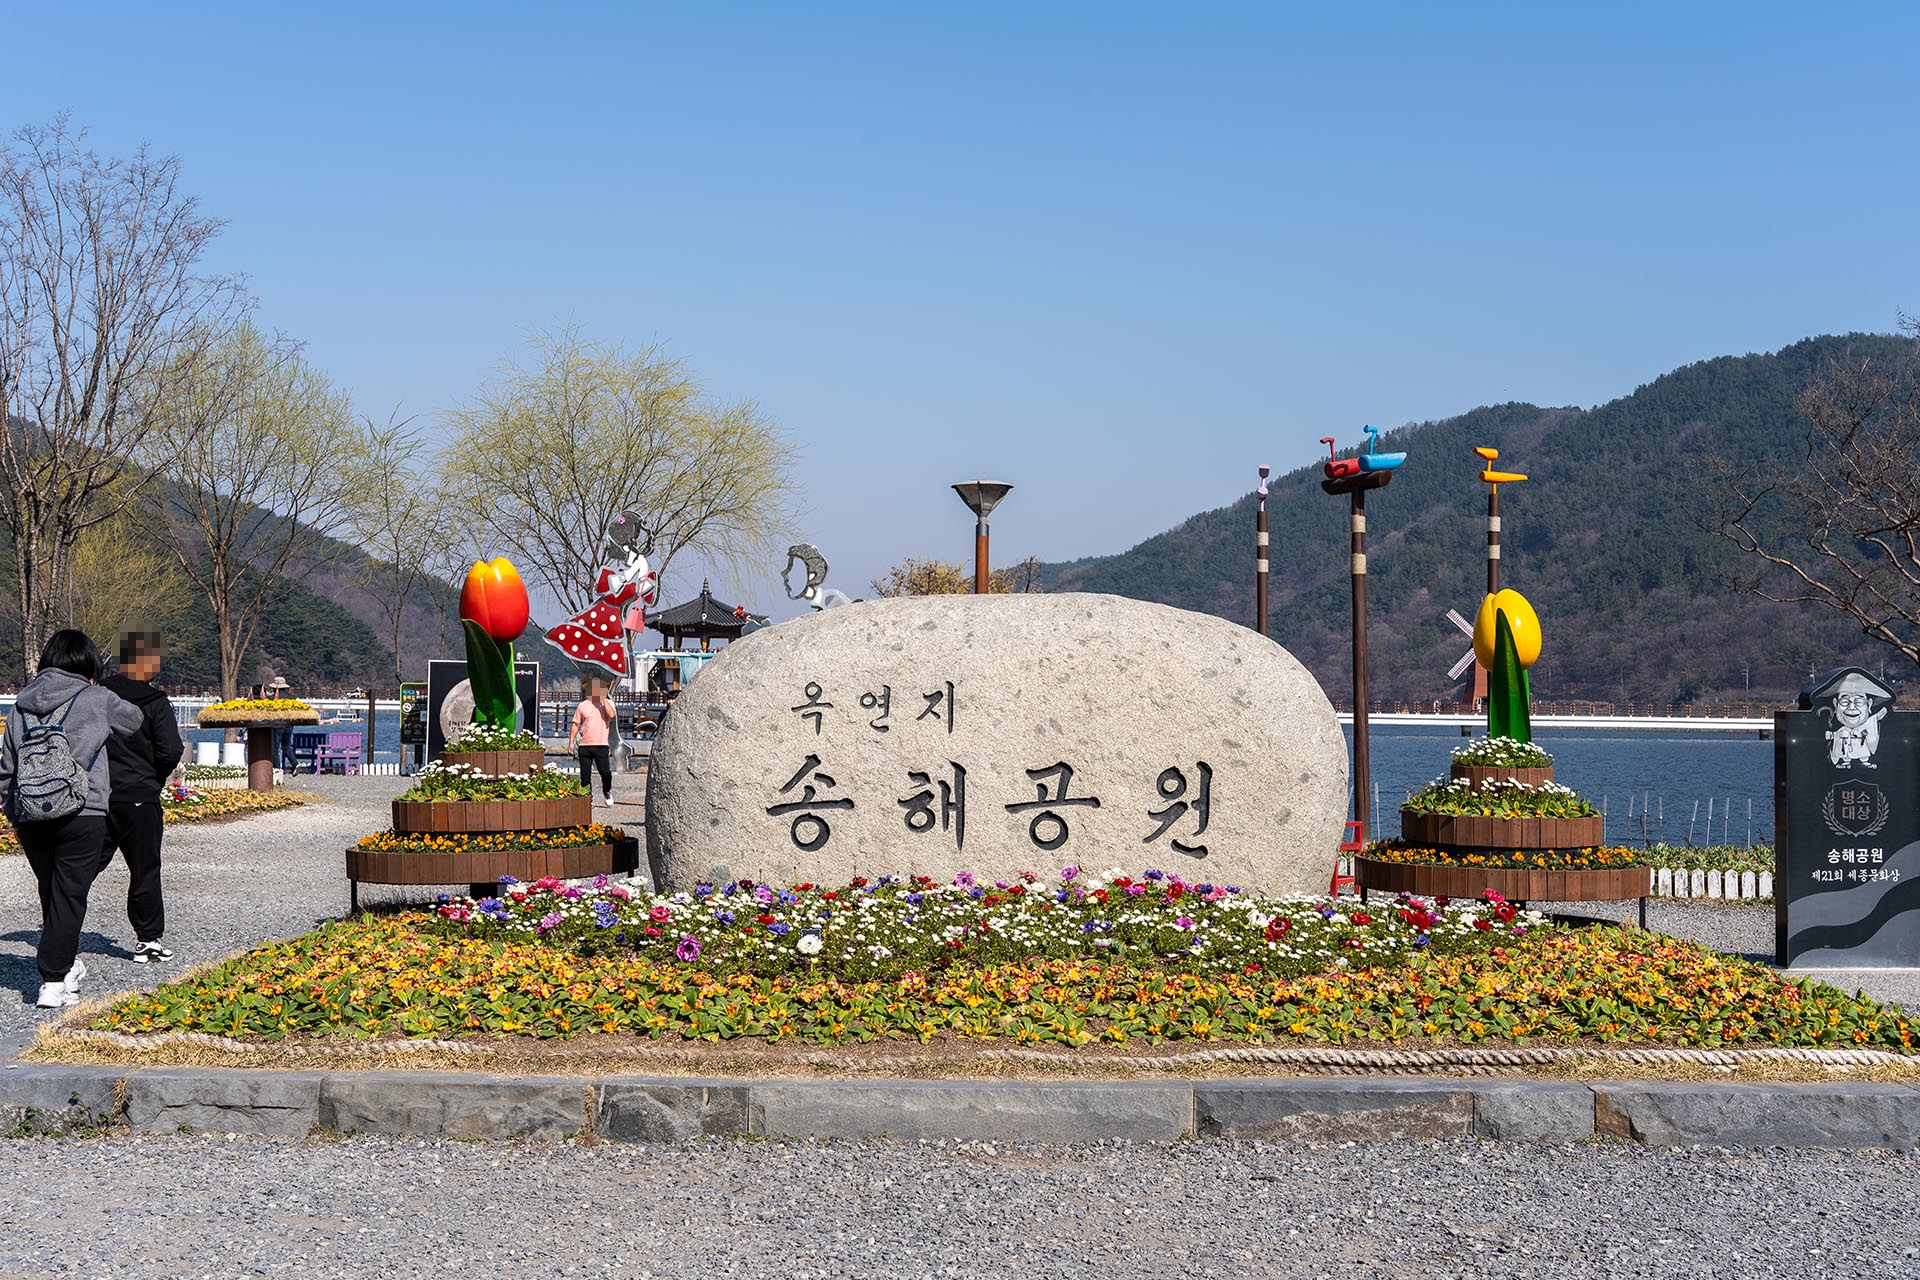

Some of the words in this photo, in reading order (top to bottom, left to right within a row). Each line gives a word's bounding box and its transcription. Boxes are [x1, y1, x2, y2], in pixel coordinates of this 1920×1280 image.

[790, 680, 956, 737] 옥연지
[1841, 790, 1871, 805] 명소
[765, 753, 1214, 860] 송해공원
[1841, 805, 1871, 821] 대상
[1827, 848, 1883, 864] 송해공원
[1811, 868, 1843, 882] 제21회
[1847, 868, 1900, 882] 세종문화상
